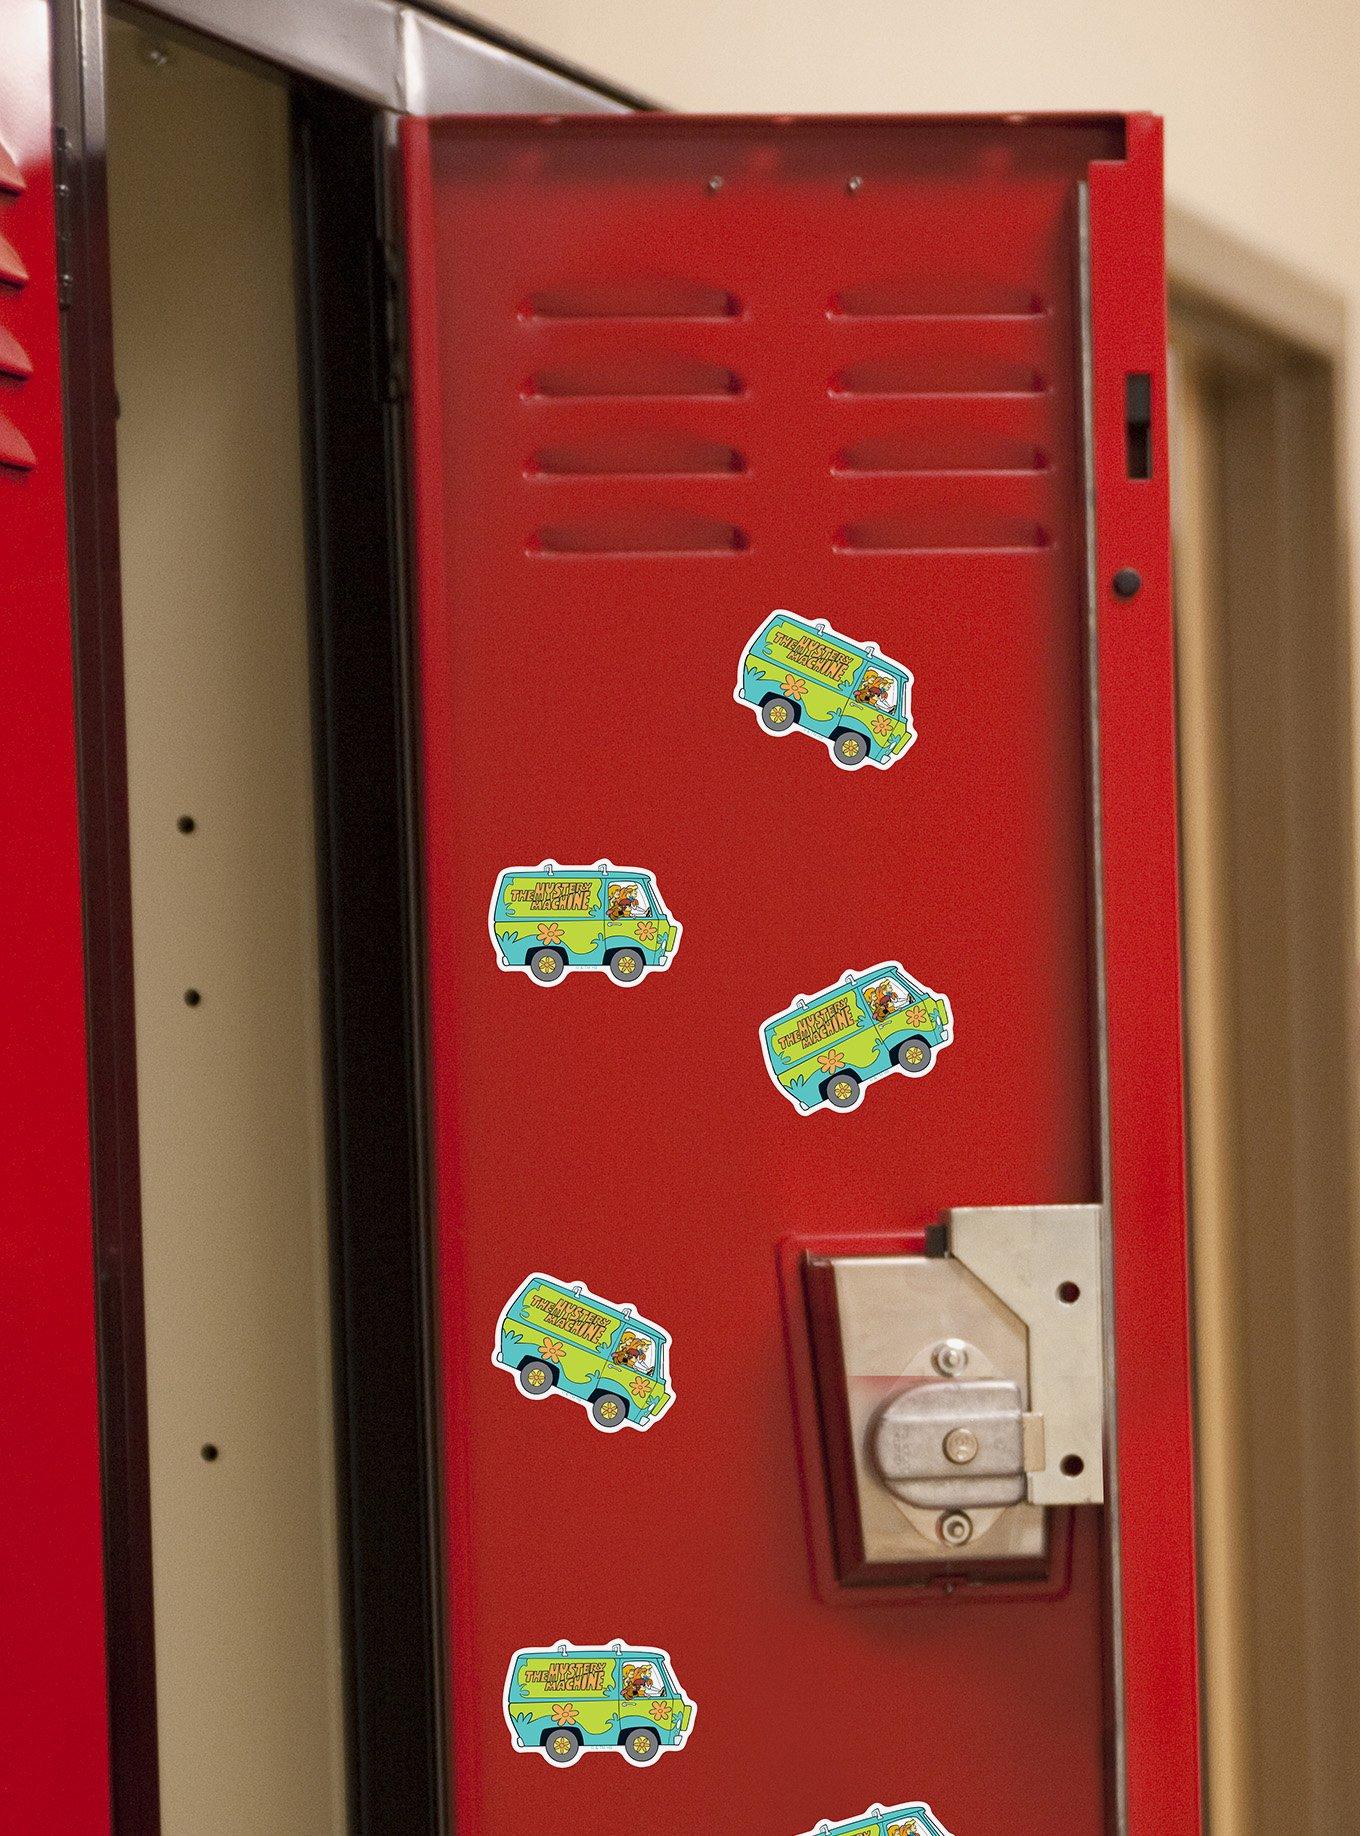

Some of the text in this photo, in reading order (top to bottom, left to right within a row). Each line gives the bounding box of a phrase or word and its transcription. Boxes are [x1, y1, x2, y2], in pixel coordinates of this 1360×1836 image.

[773, 631, 854, 665] THE MYSTERY
[786, 651, 849, 682] MACHINE
[511, 882, 592, 902] THE MYSTERY
[530, 891, 591, 910] MACHINE
[778, 997, 848, 1050] THE MYSTERY
[801, 1005, 854, 1049] MACHINE
[530, 1294, 611, 1327] THE MYSTERY
[543, 1314, 607, 1344] MACHINE
[525, 1663, 606, 1682] THE MYSTERY
[544, 1671, 605, 1691] MACHINE
